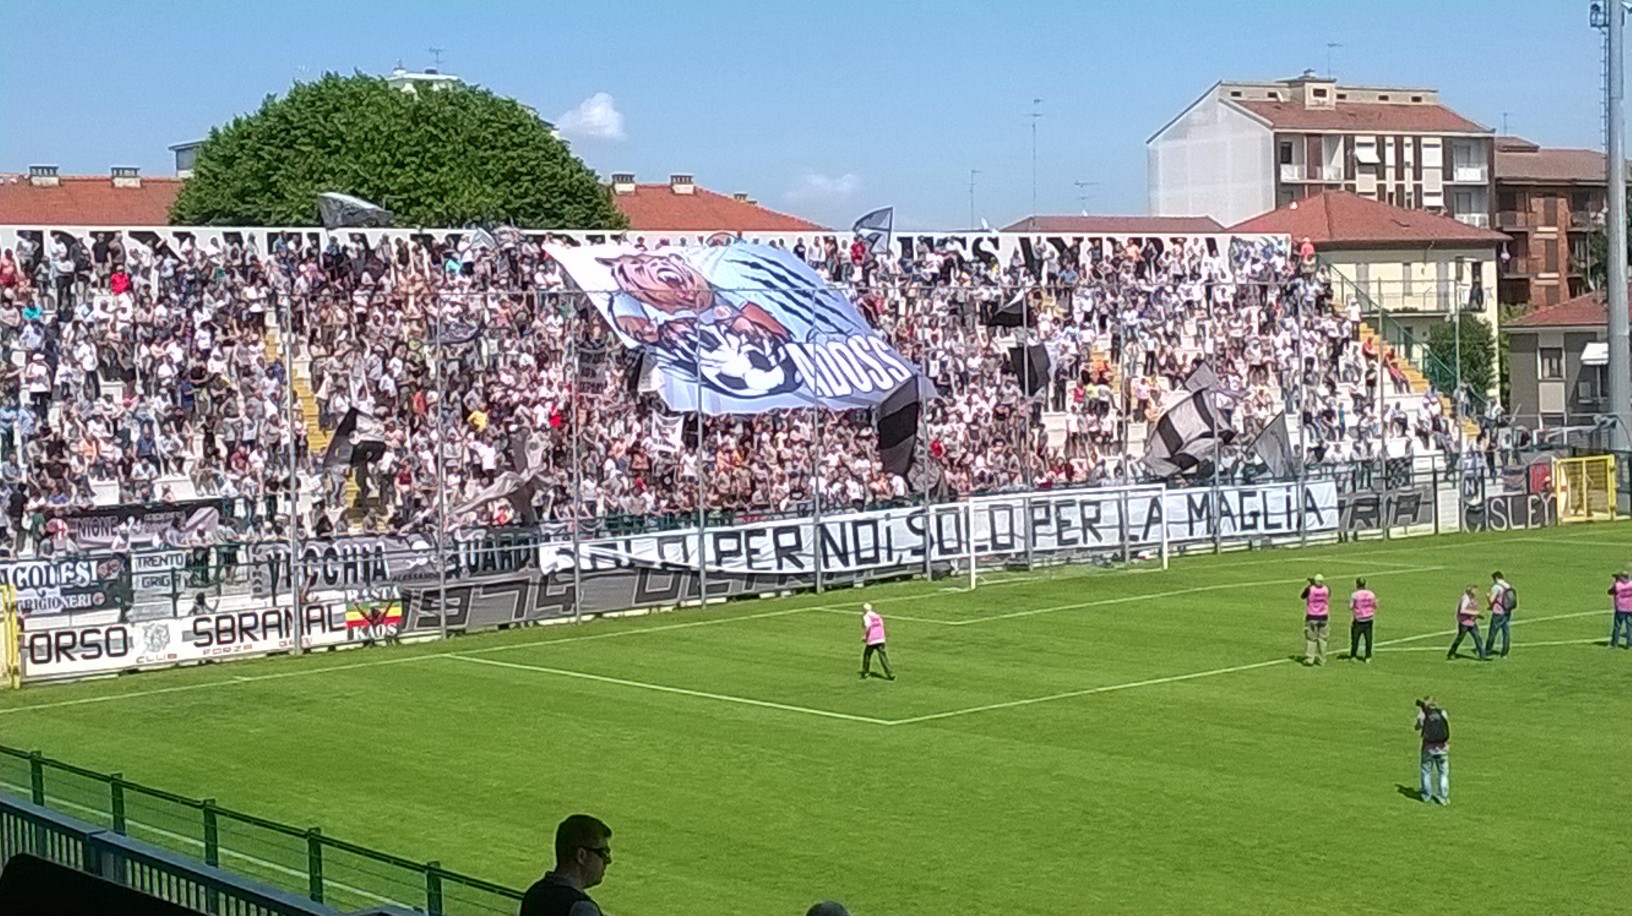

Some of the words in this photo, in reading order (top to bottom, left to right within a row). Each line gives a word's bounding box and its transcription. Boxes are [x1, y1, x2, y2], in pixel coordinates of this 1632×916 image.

[713, 525, 805, 571] PER
[906, 506, 1014, 556] SOLO
[1028, 499, 1103, 547] PER
[1117, 496, 1169, 543] LA
[136, 553, 183, 568] TRENTO
[353, 623, 398, 641] KAOS
[29, 626, 128, 665] ORSO
[136, 652, 178, 664] CLUB
